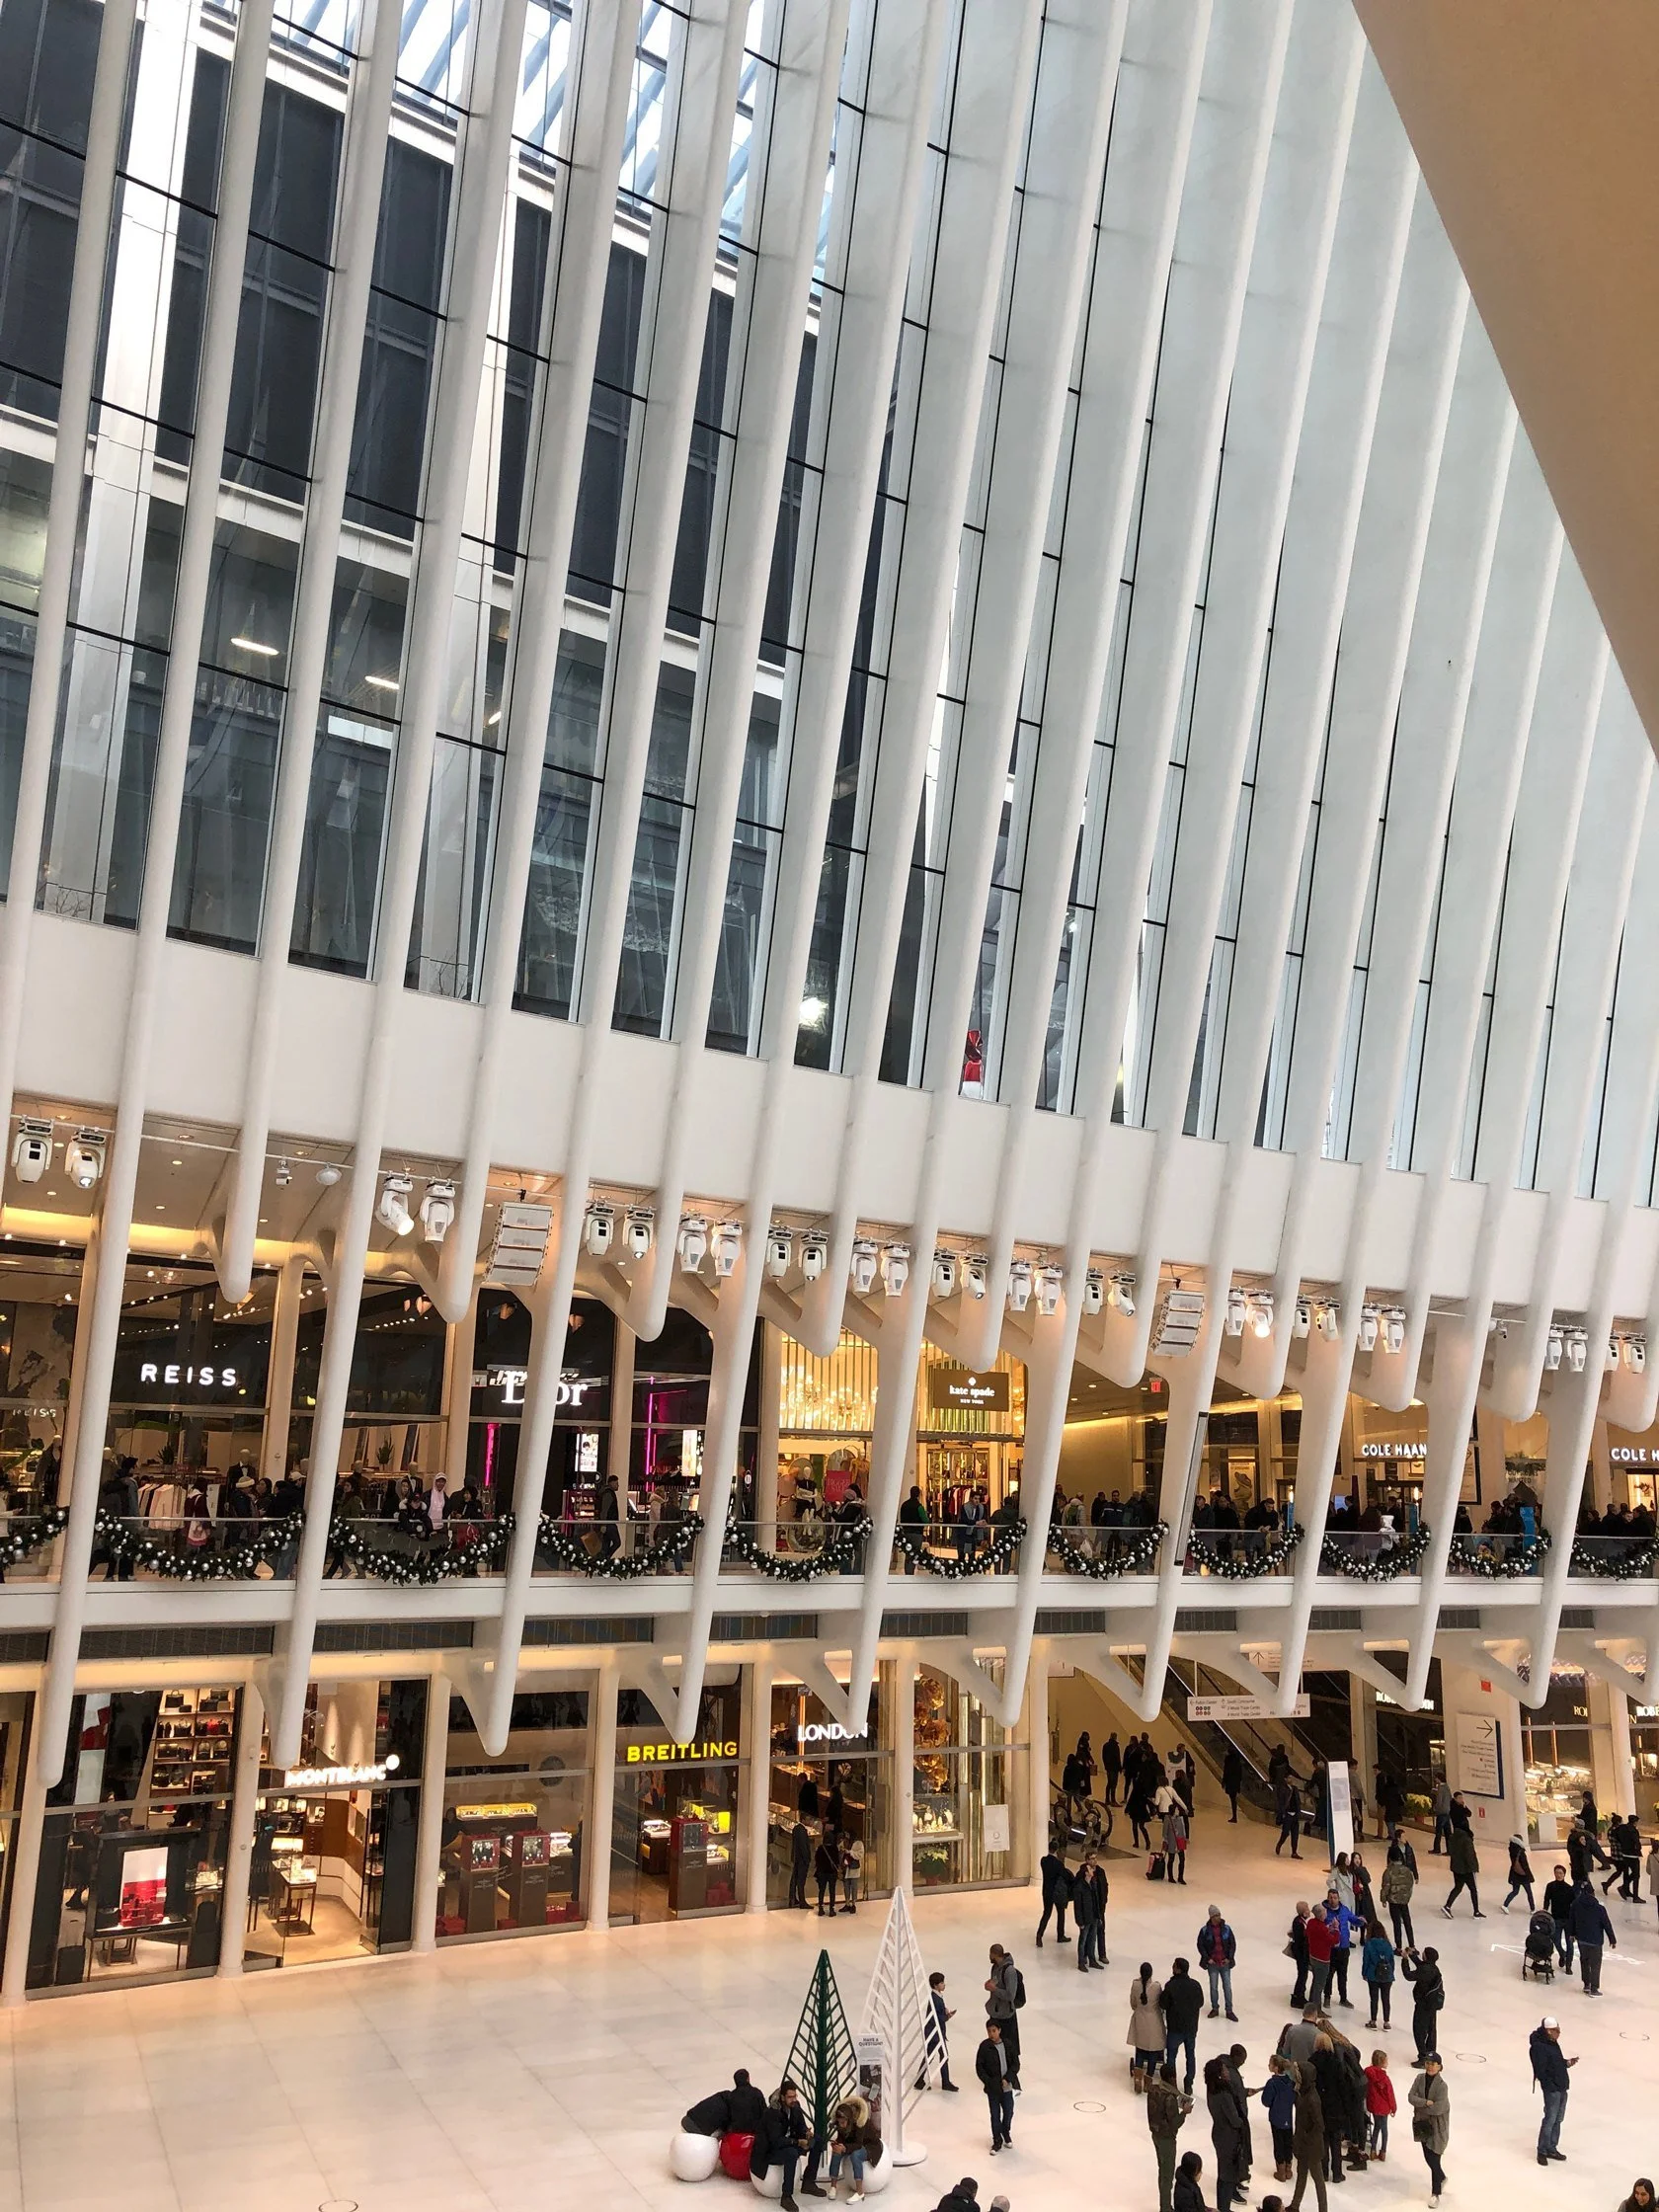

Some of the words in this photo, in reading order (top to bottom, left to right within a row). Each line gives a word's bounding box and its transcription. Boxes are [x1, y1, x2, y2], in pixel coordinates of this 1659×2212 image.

[140, 1363, 237, 1386] REISS
[501, 1371, 589, 1406] Dor
[949, 1384, 969, 1395] kate
[970, 1386, 995, 1398] spade
[1362, 1444, 1390, 1457] COLE
[1394, 1444, 1427, 1457] HAAN
[1611, 1448, 1647, 1462] COLE
[627, 1741, 738, 1763] BREITLING
[286, 1764, 387, 1785] MONTBLANC
